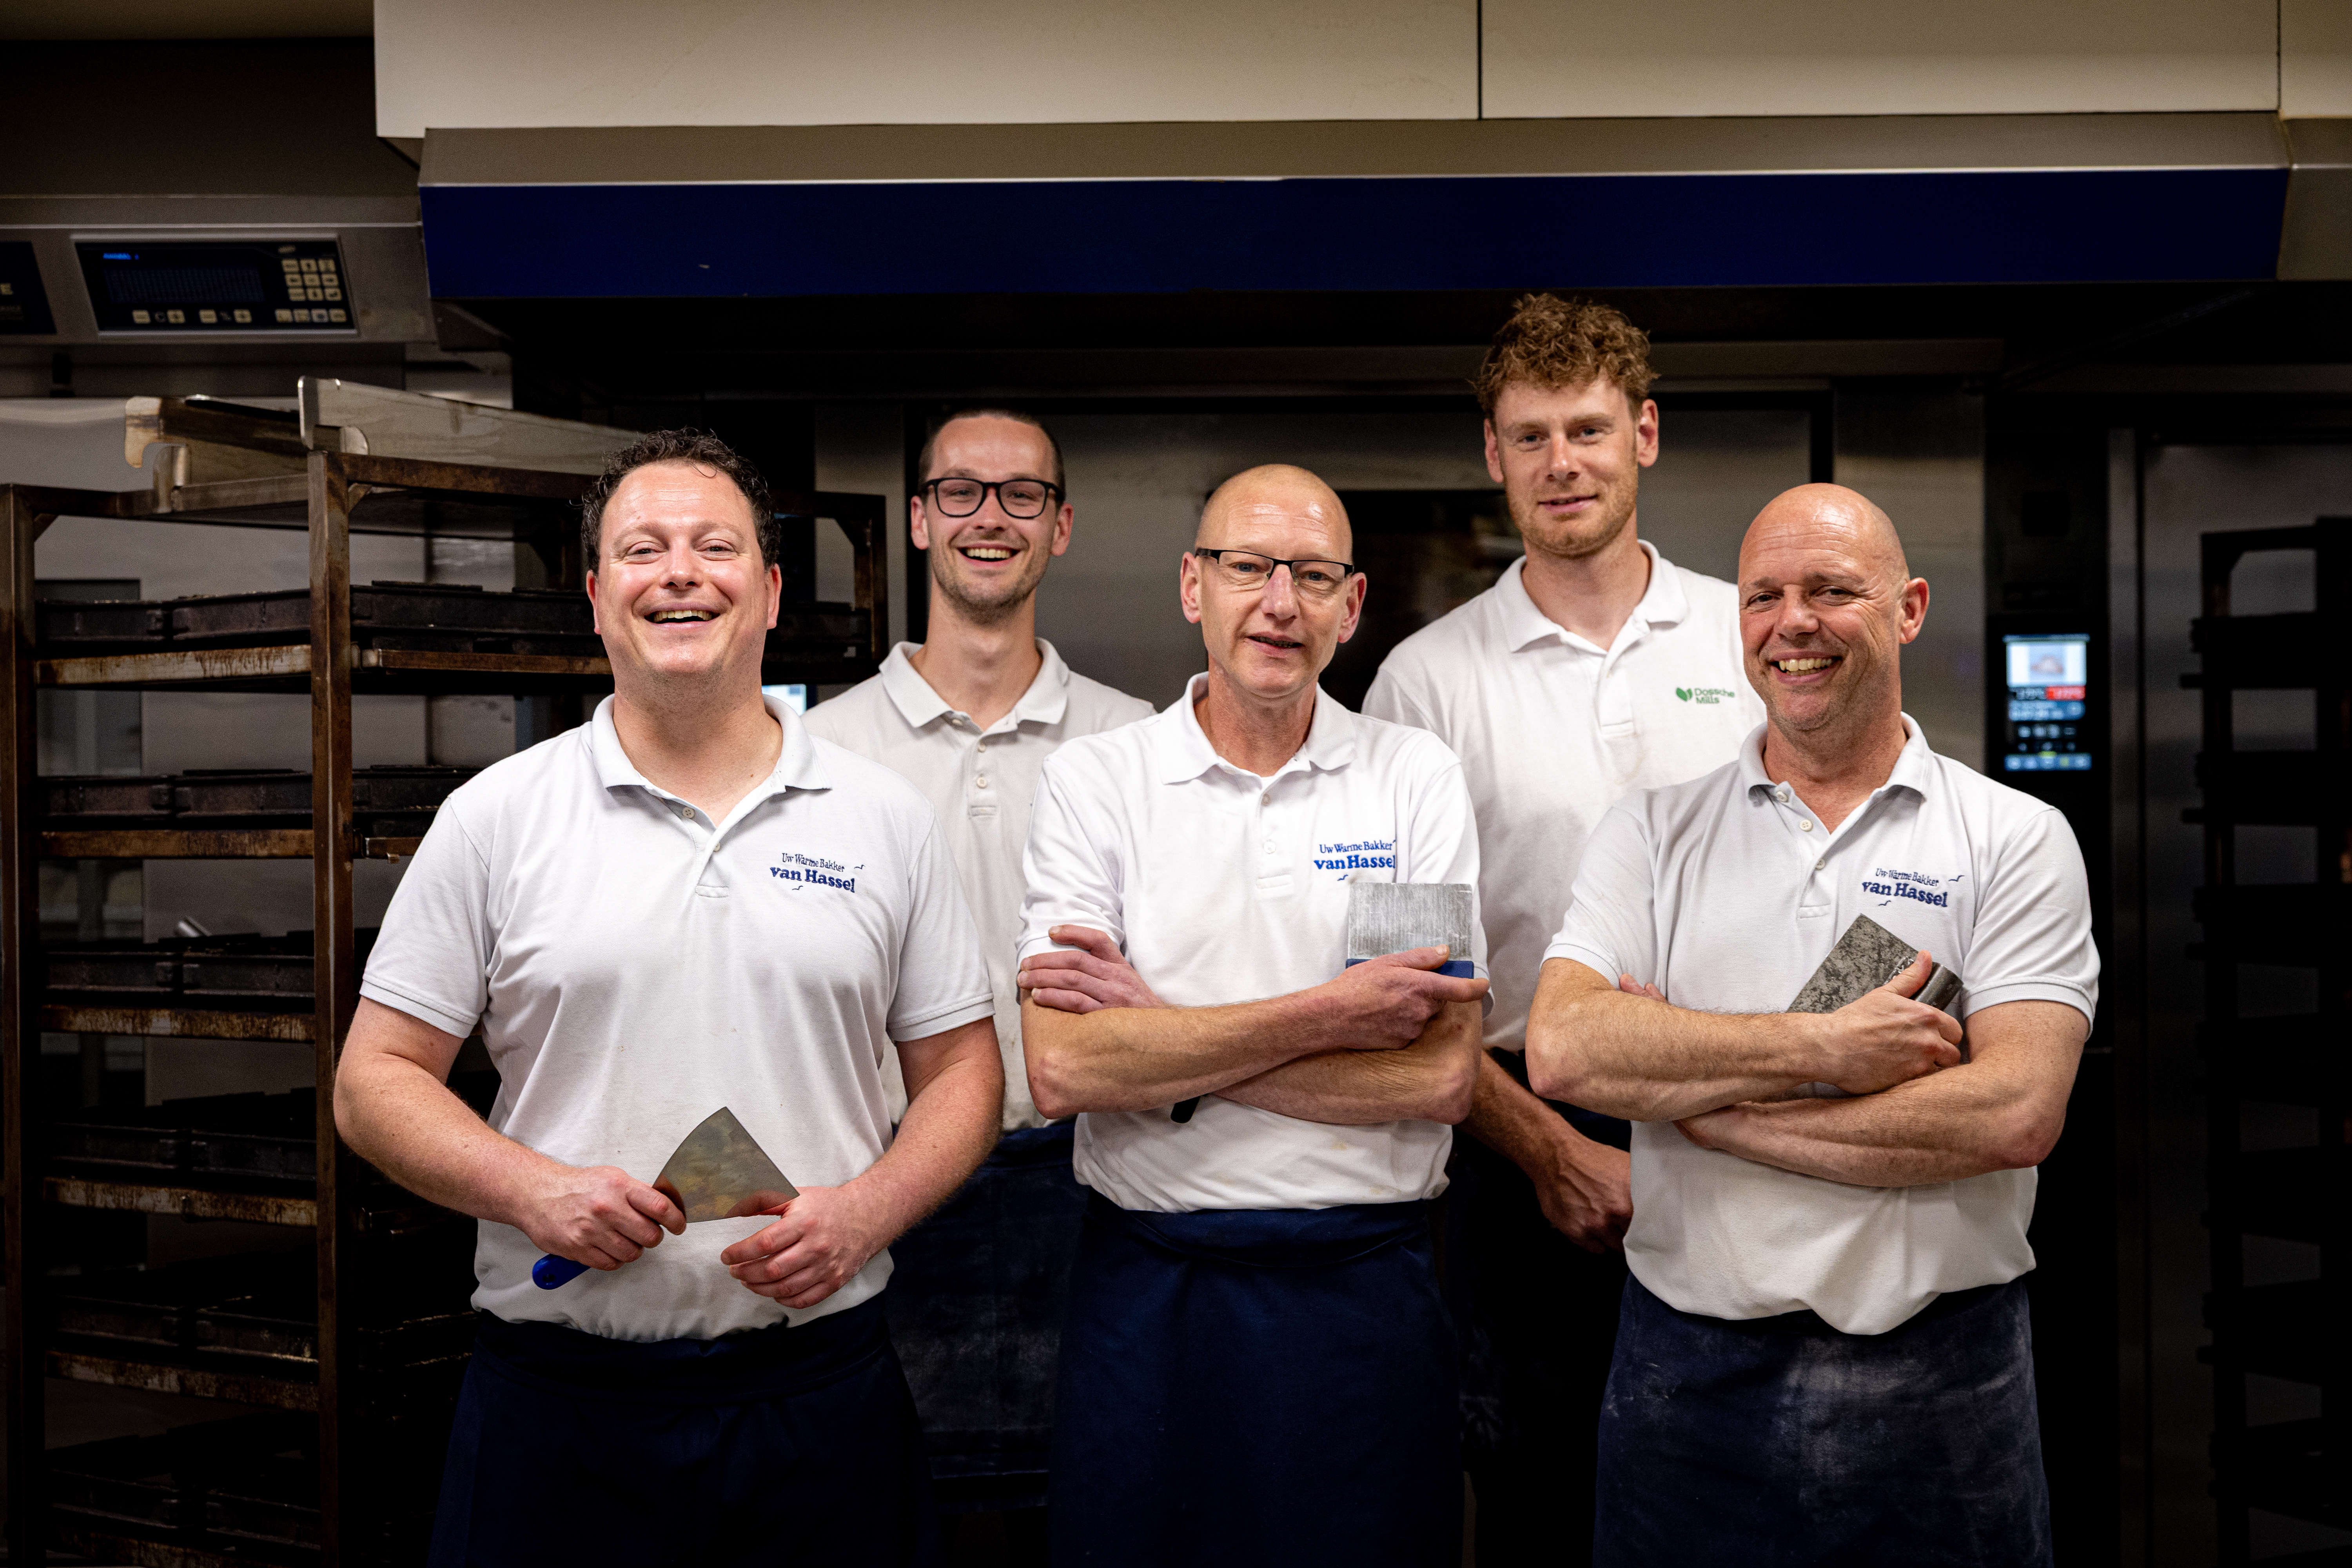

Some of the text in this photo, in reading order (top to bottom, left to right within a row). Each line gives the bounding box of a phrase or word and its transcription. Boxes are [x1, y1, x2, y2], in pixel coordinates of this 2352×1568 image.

[1319, 840, 1392, 853] Uw Warme Bakker
[782, 852, 845, 872] Uw Warme Bakker
[1314, 855, 1396, 869] van Hassel
[770, 867, 855, 893] van Hassel
[1876, 868, 1939, 887] Uw Warme Bakker
[1862, 882, 1948, 907] van Hassel
